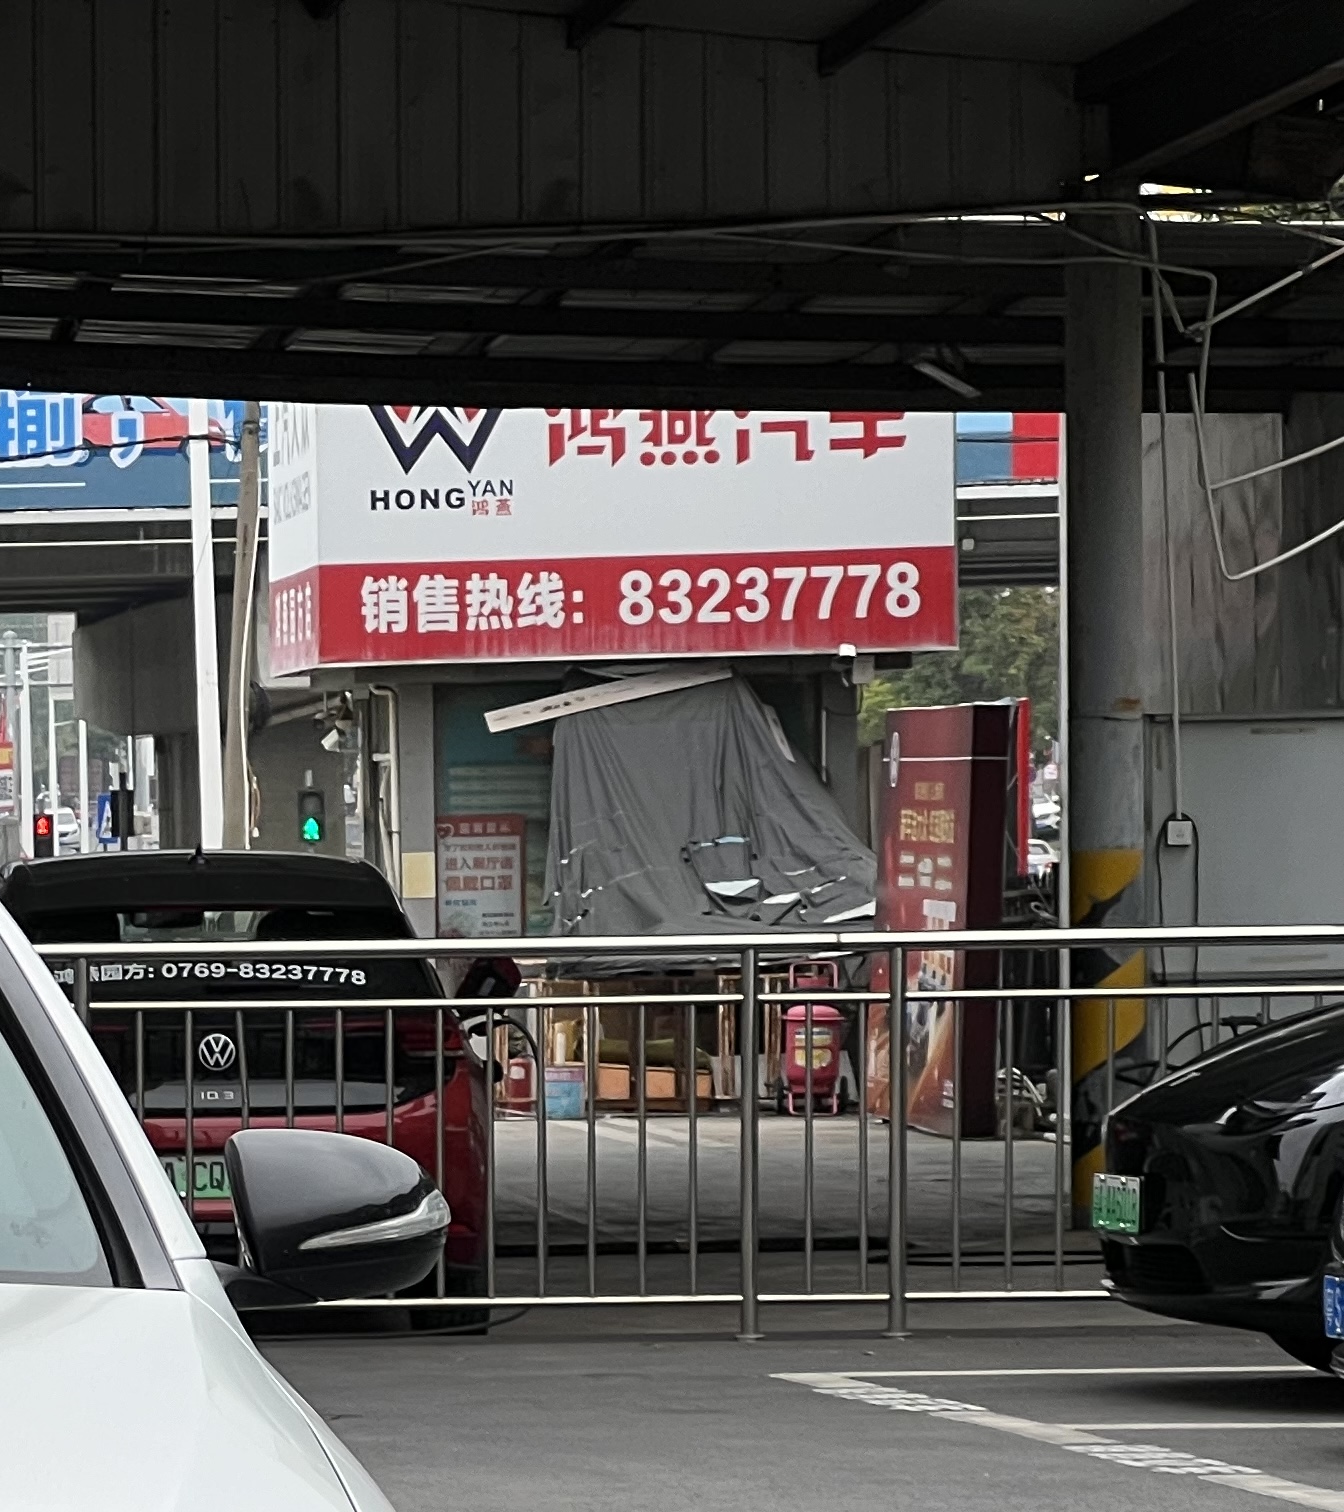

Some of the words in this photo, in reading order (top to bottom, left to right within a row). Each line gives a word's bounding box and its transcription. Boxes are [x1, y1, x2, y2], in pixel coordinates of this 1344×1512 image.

[370, 487, 466, 511] HONG
[467, 479, 514, 498] YAN
[619, 562, 922, 626] 83237778
[161, 962, 367, 985] 0769-83237778
